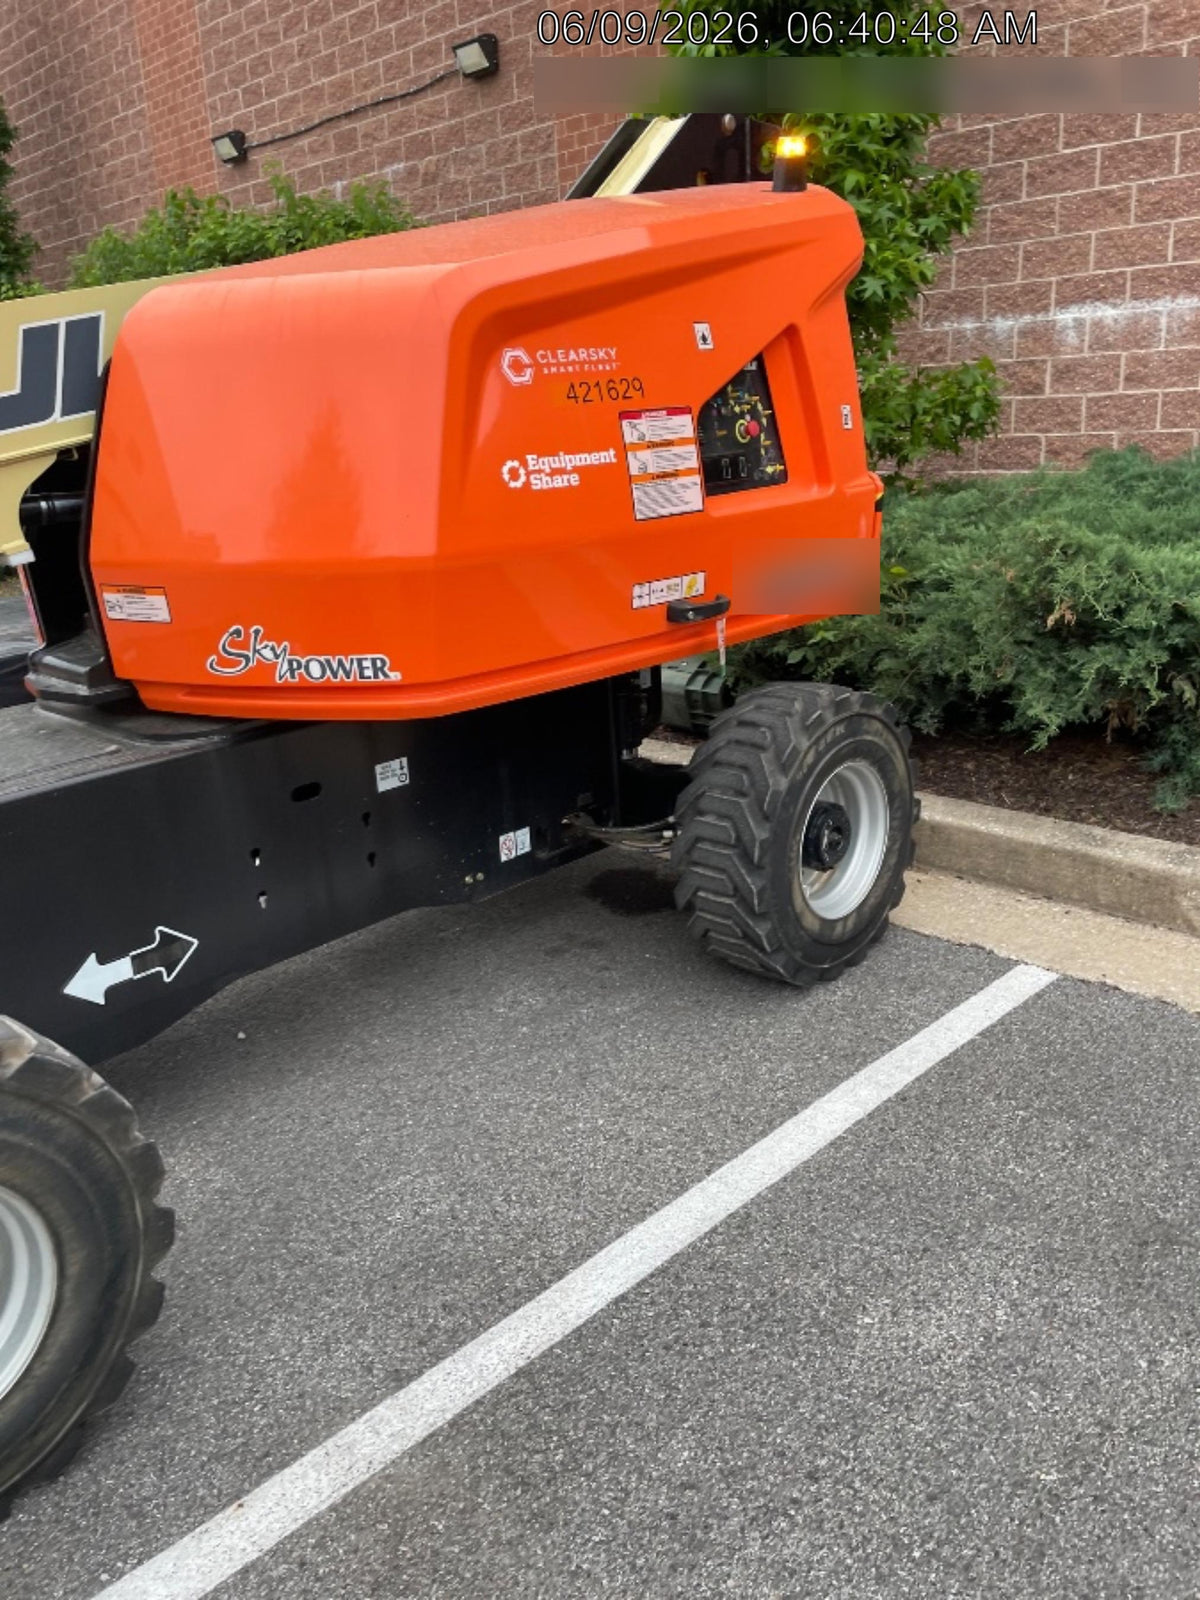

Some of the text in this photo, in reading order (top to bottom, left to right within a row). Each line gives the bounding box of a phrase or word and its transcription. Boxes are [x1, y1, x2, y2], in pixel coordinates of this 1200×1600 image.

[536, 347, 617, 363] CLEARSKY
[566, 377, 645, 404] 421629
[526, 448, 617, 473] Equipment
[529, 472, 580, 490] Share
